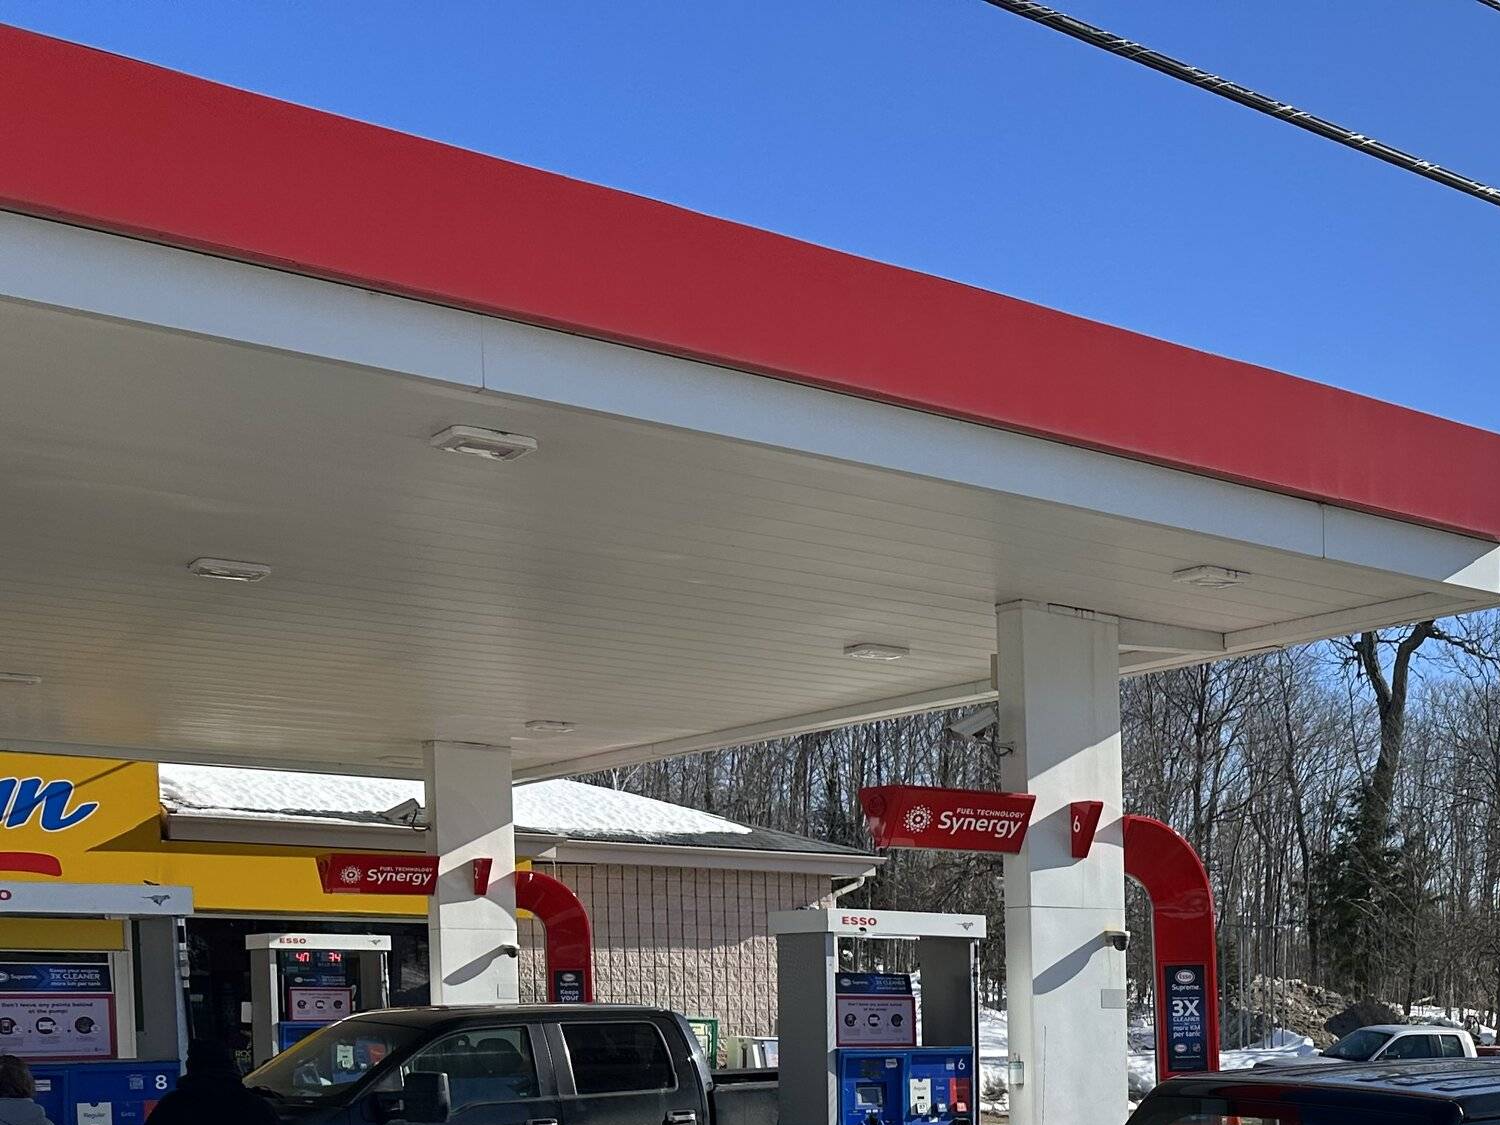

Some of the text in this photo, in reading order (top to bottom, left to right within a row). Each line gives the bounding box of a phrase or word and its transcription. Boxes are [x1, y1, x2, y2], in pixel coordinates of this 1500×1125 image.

[956, 807, 1026, 819] FUEL TECHNOLOGY
[937, 812, 1023, 839] Synergy
[1073, 815, 1081, 834] 6
[366, 868, 432, 886] Synergy
[841, 916, 878, 926] ESSO
[279, 937, 307, 945] ESSO
[1172, 999, 1200, 1017] 3X
[957, 1058, 966, 1070] 6
[155, 1074, 168, 1090] 8
